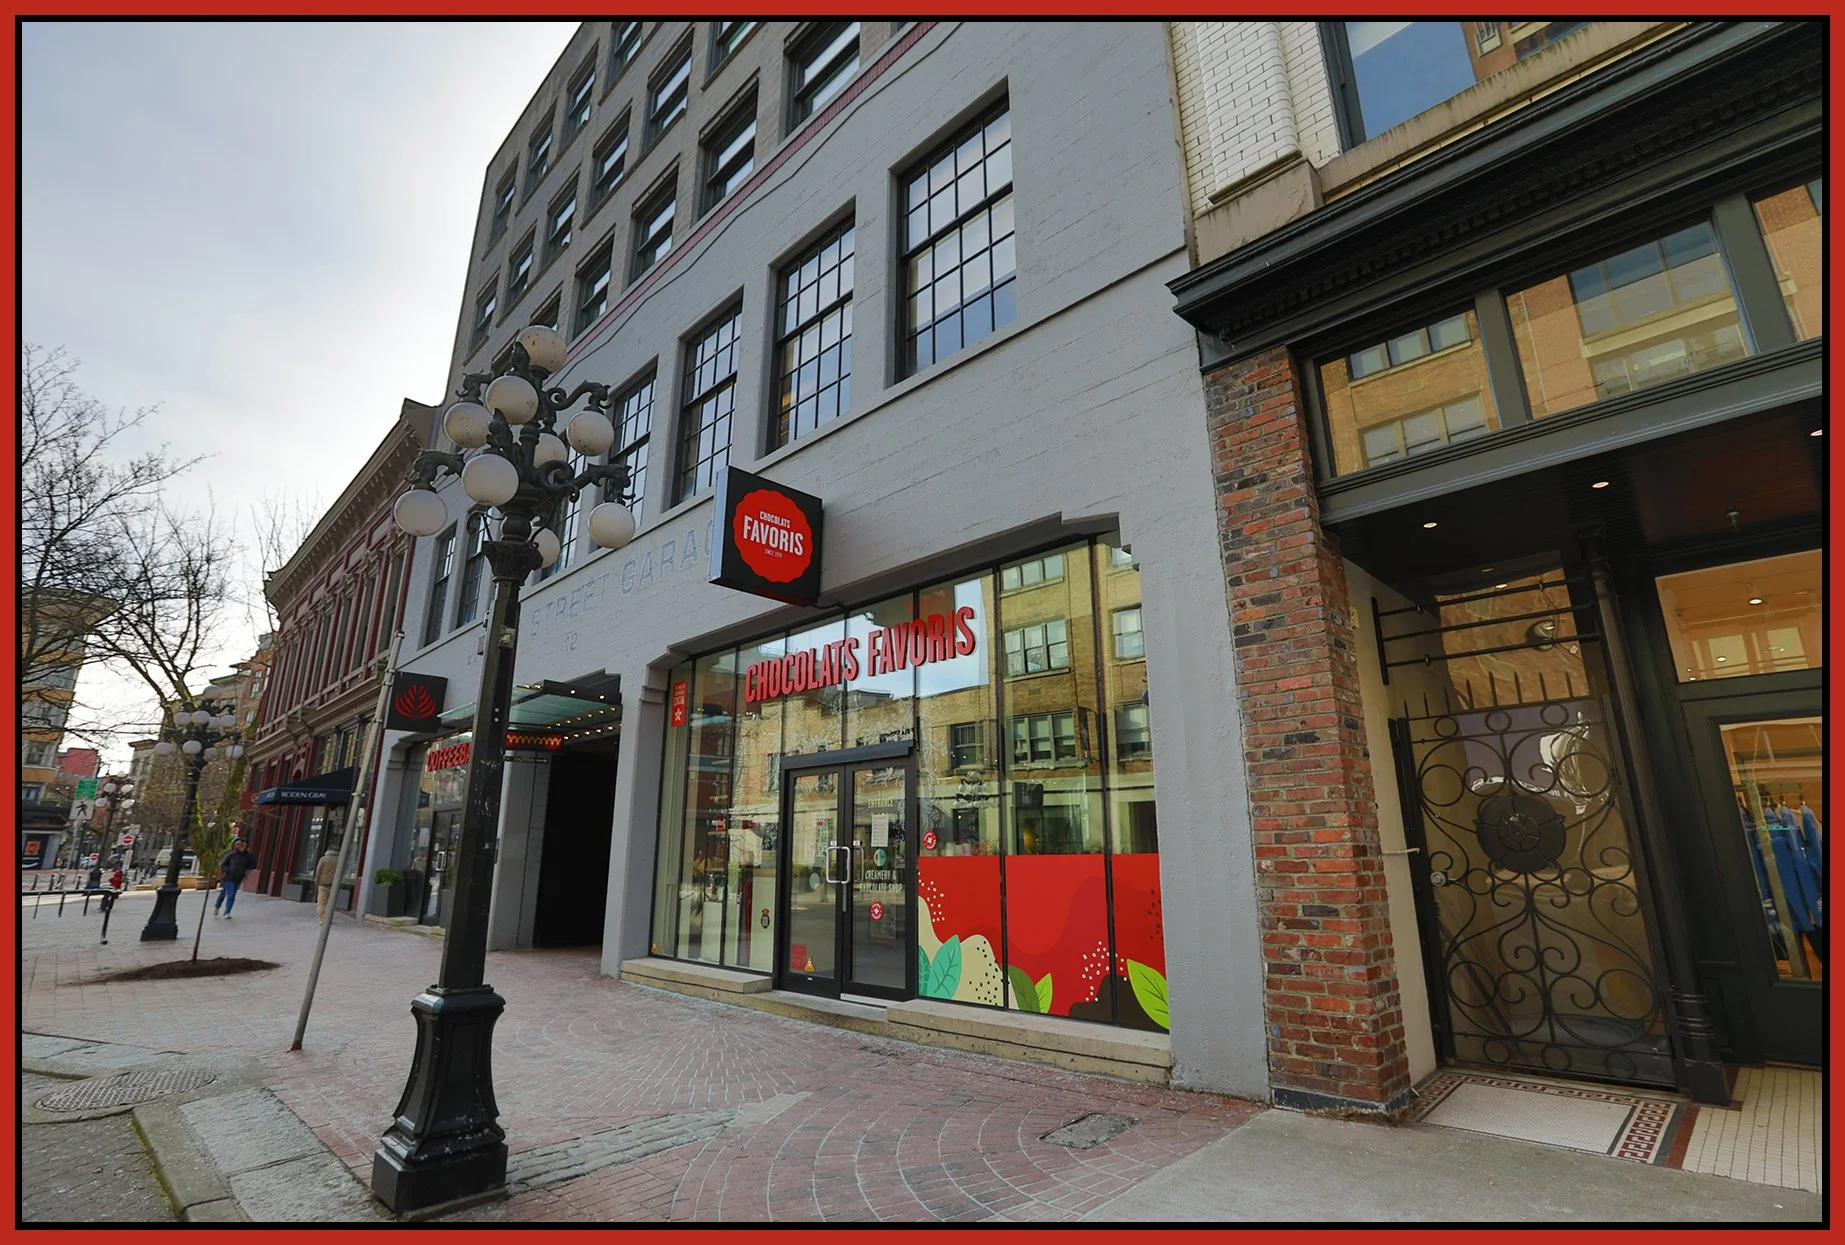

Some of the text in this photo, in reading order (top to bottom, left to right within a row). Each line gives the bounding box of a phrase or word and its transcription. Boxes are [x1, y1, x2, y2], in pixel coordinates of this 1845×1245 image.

[759, 510, 791, 529] CHOCOLATS
[742, 514, 804, 557] FAVORIS
[530, 571, 611, 641] STREET
[744, 605, 977, 704] CHOCOLATS FAVORIS
[281, 790, 307, 799] RODEN
[308, 791, 328, 799] GRAY
[864, 869, 891, 880] CREAMERY
[888, 882, 903, 894] SHOP
